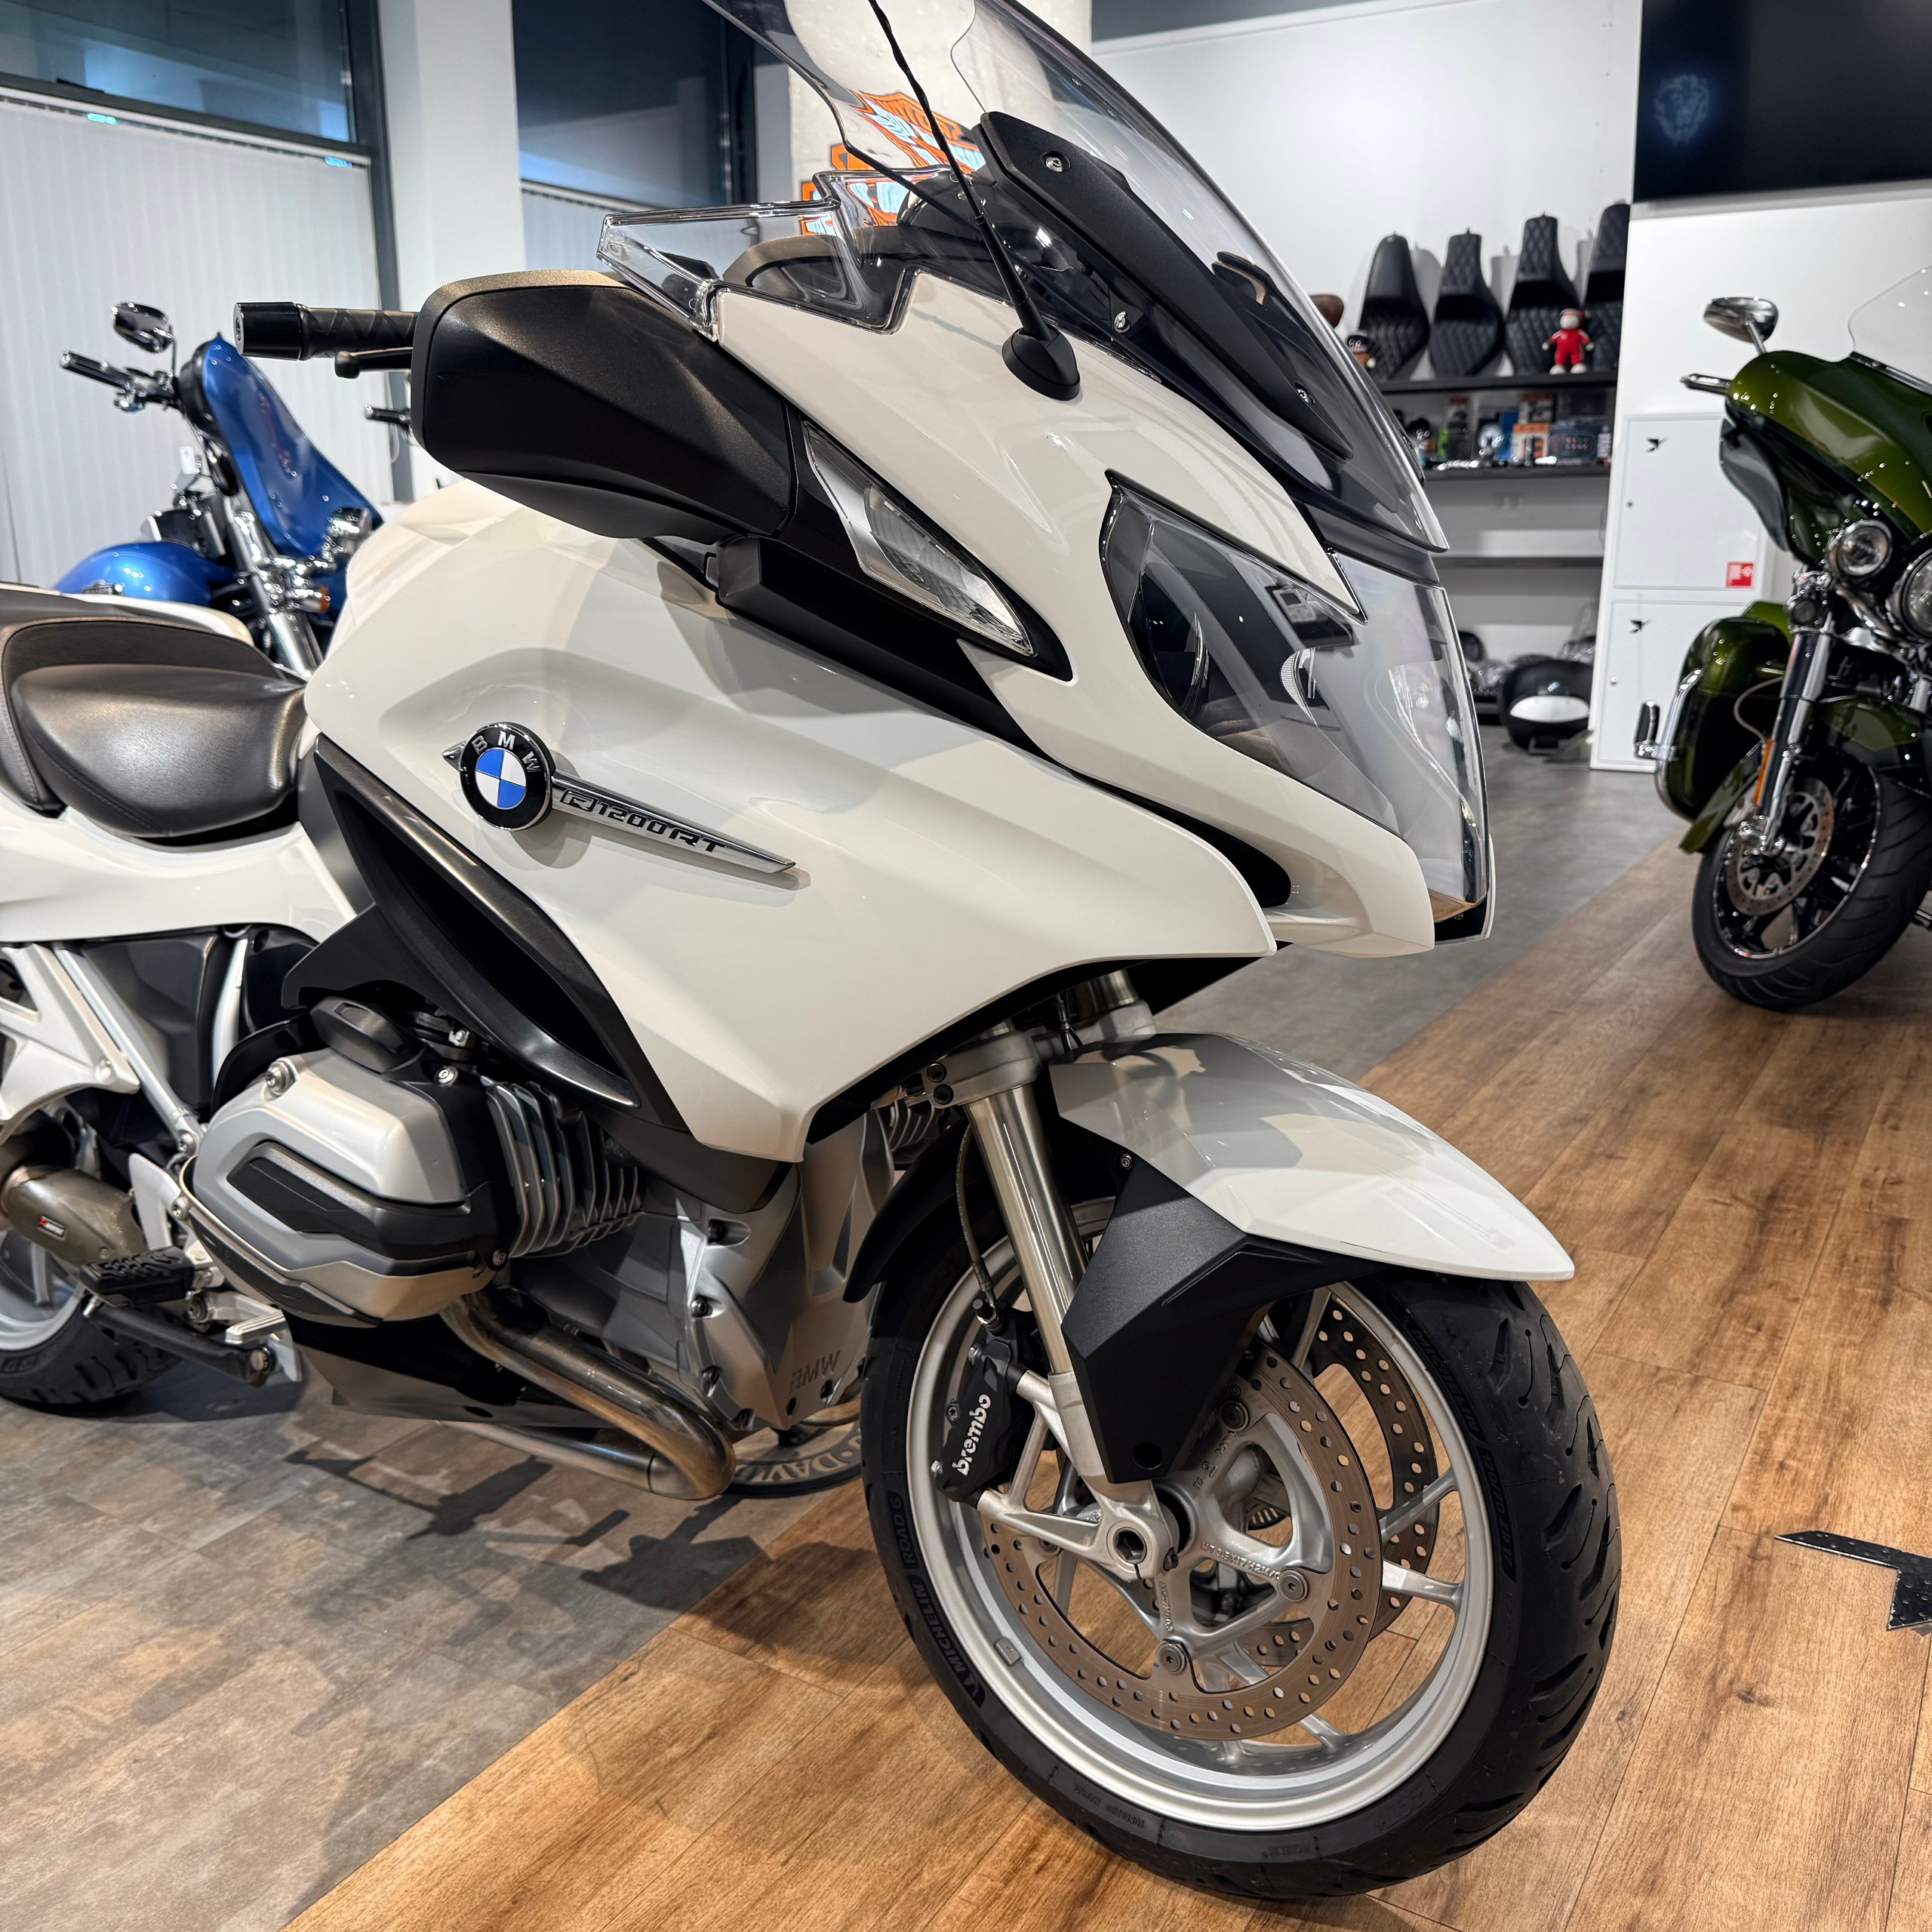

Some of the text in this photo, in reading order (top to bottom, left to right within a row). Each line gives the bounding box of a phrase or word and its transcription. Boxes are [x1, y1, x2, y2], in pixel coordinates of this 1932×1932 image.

[471, 730, 540, 773] BMW
[789, 1349, 841, 1393] BMW
[1411, 1331, 1479, 1432] MICHELIN
[952, 1394, 992, 1476] brembo
[1482, 1455, 1505, 1512] 120/70
[891, 1497, 915, 1565] ROAD 6
[912, 1583, 968, 1674] MICHELIN
